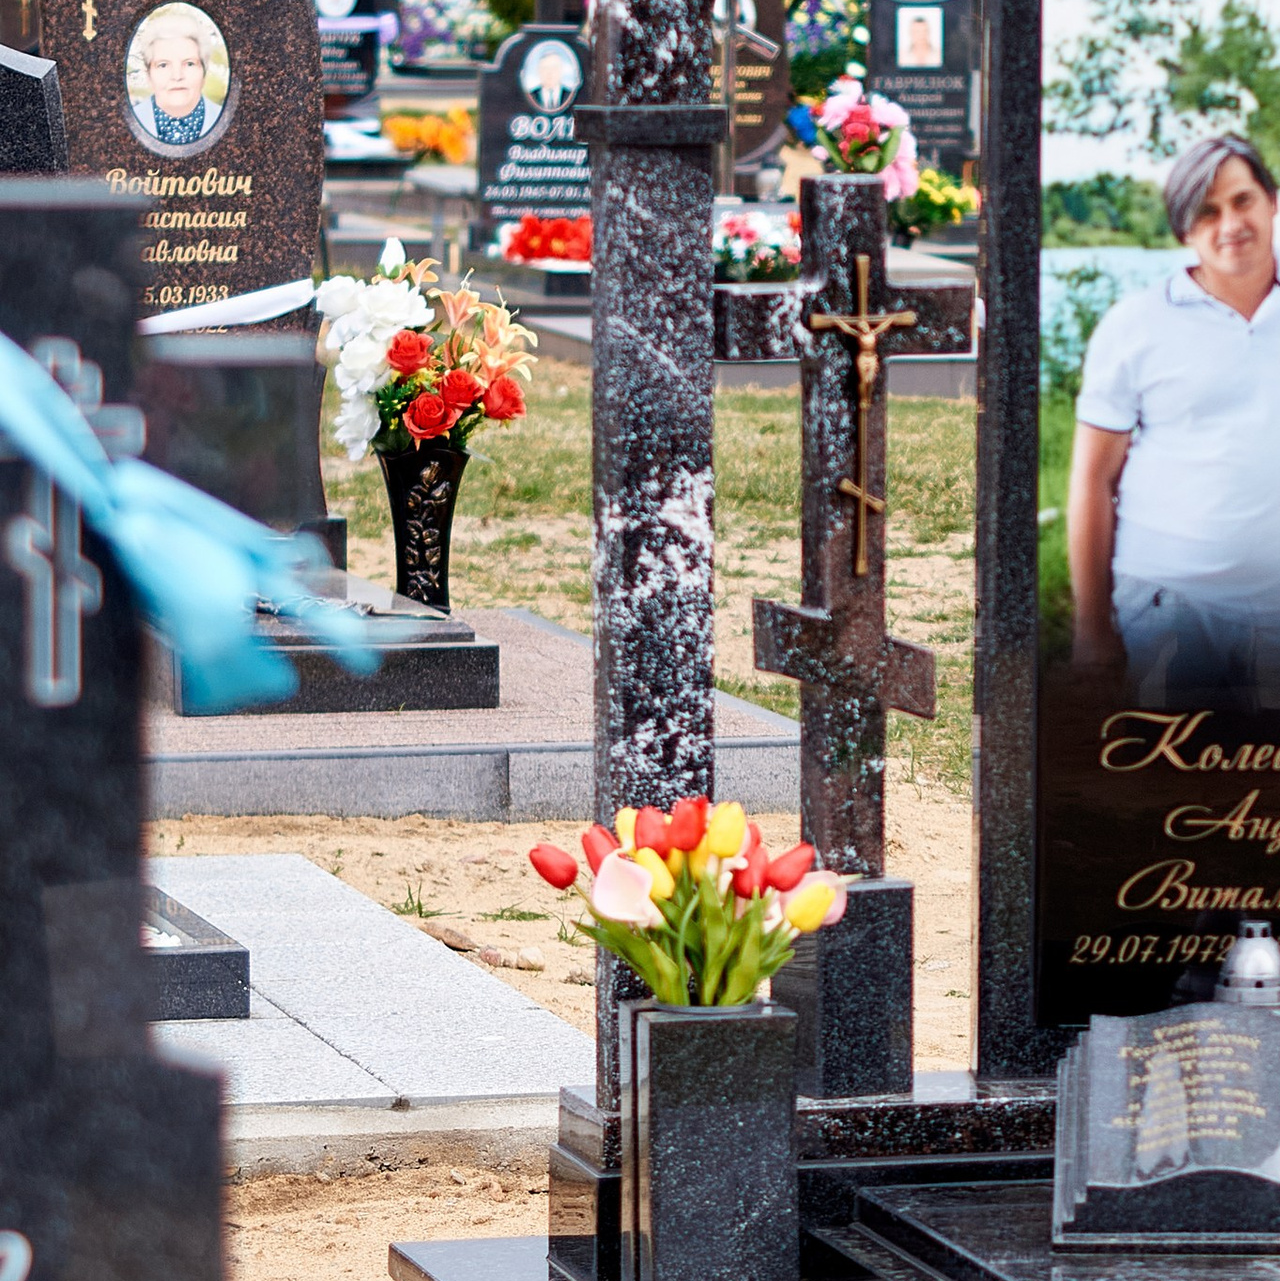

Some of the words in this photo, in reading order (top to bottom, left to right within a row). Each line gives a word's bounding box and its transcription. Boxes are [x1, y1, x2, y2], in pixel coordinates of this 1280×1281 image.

[507, 144, 587, 165] Владимир
[106, 168, 252, 196] Войтович
[145, 211, 247, 228] астасия
[141, 239, 239, 262] авловна
[144, 285, 229, 304] 5.03.1933
[1069, 934, 1237, 964] 29.07.1972
